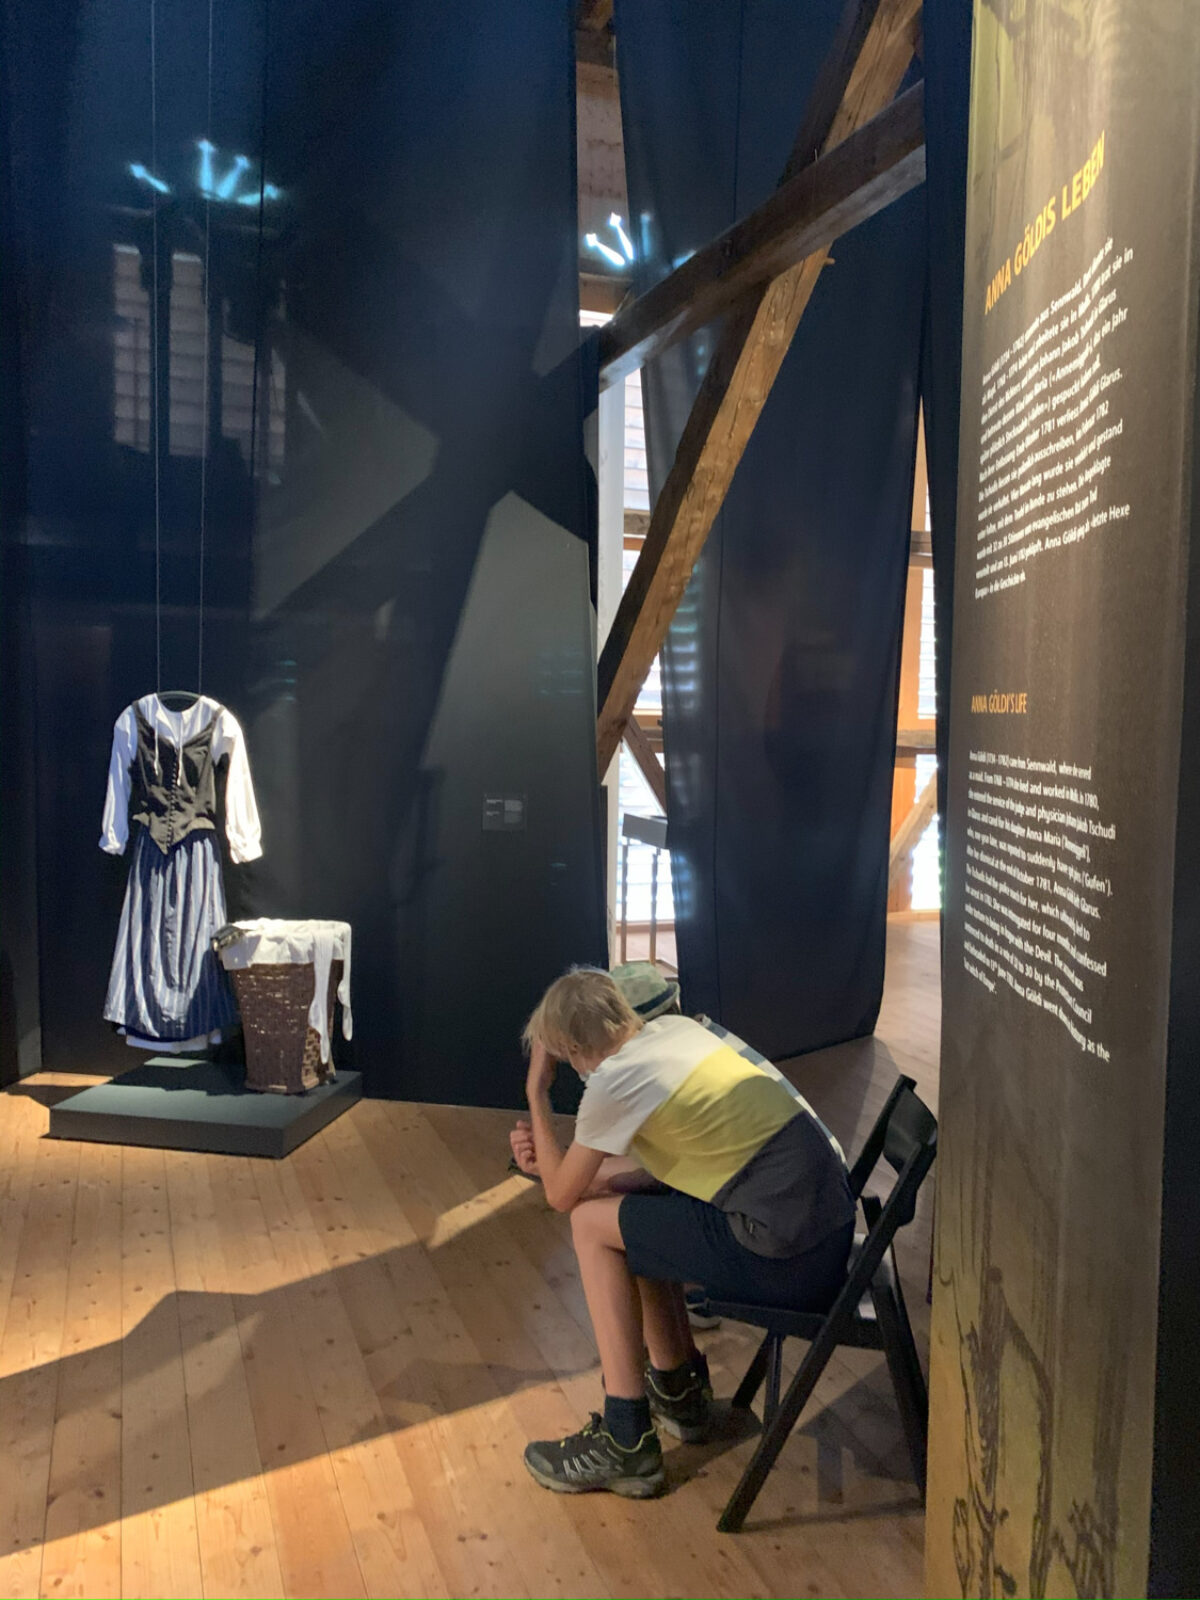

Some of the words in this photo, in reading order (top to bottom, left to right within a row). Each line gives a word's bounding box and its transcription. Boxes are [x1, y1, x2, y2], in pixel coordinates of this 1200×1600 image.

[985, 258, 1011, 315] ANNA
[1014, 196, 1056, 275] GÖLDIS
[1062, 130, 1104, 220] LEBEN
[1113, 255, 1122, 274] sie
[1124, 247, 1133, 263] in
[1112, 307, 1128, 332] Jahr
[1065, 458, 1074, 472] sie
[1097, 418, 1123, 450] gestand
[1044, 537, 1061, 551] Anna
[1109, 503, 1130, 520] Hexe
[971, 695, 987, 713] ANNA
[1026, 757, 1057, 776] Sennwald,
[1030, 781, 1041, 795] and
[1043, 783, 1065, 799] worked
[1025, 805, 1036, 818] and
[1037, 805, 1066, 824] physician
[1089, 820, 1116, 840] Tschudi
[1026, 827, 1042, 841] Anna
[1044, 830, 1061, 847] Maria
[1027, 852, 1055, 873] suddenly
[1041, 901, 1060, 918] which
[1084, 928, 1090, 941] to
[1032, 920, 1041, 935] for
[1076, 952, 1107, 977] confessed
[1034, 967, 1043, 987] by
[1044, 973, 1055, 989] the
[1087, 1038, 1095, 1054] as
[1097, 1042, 1110, 1063] the
